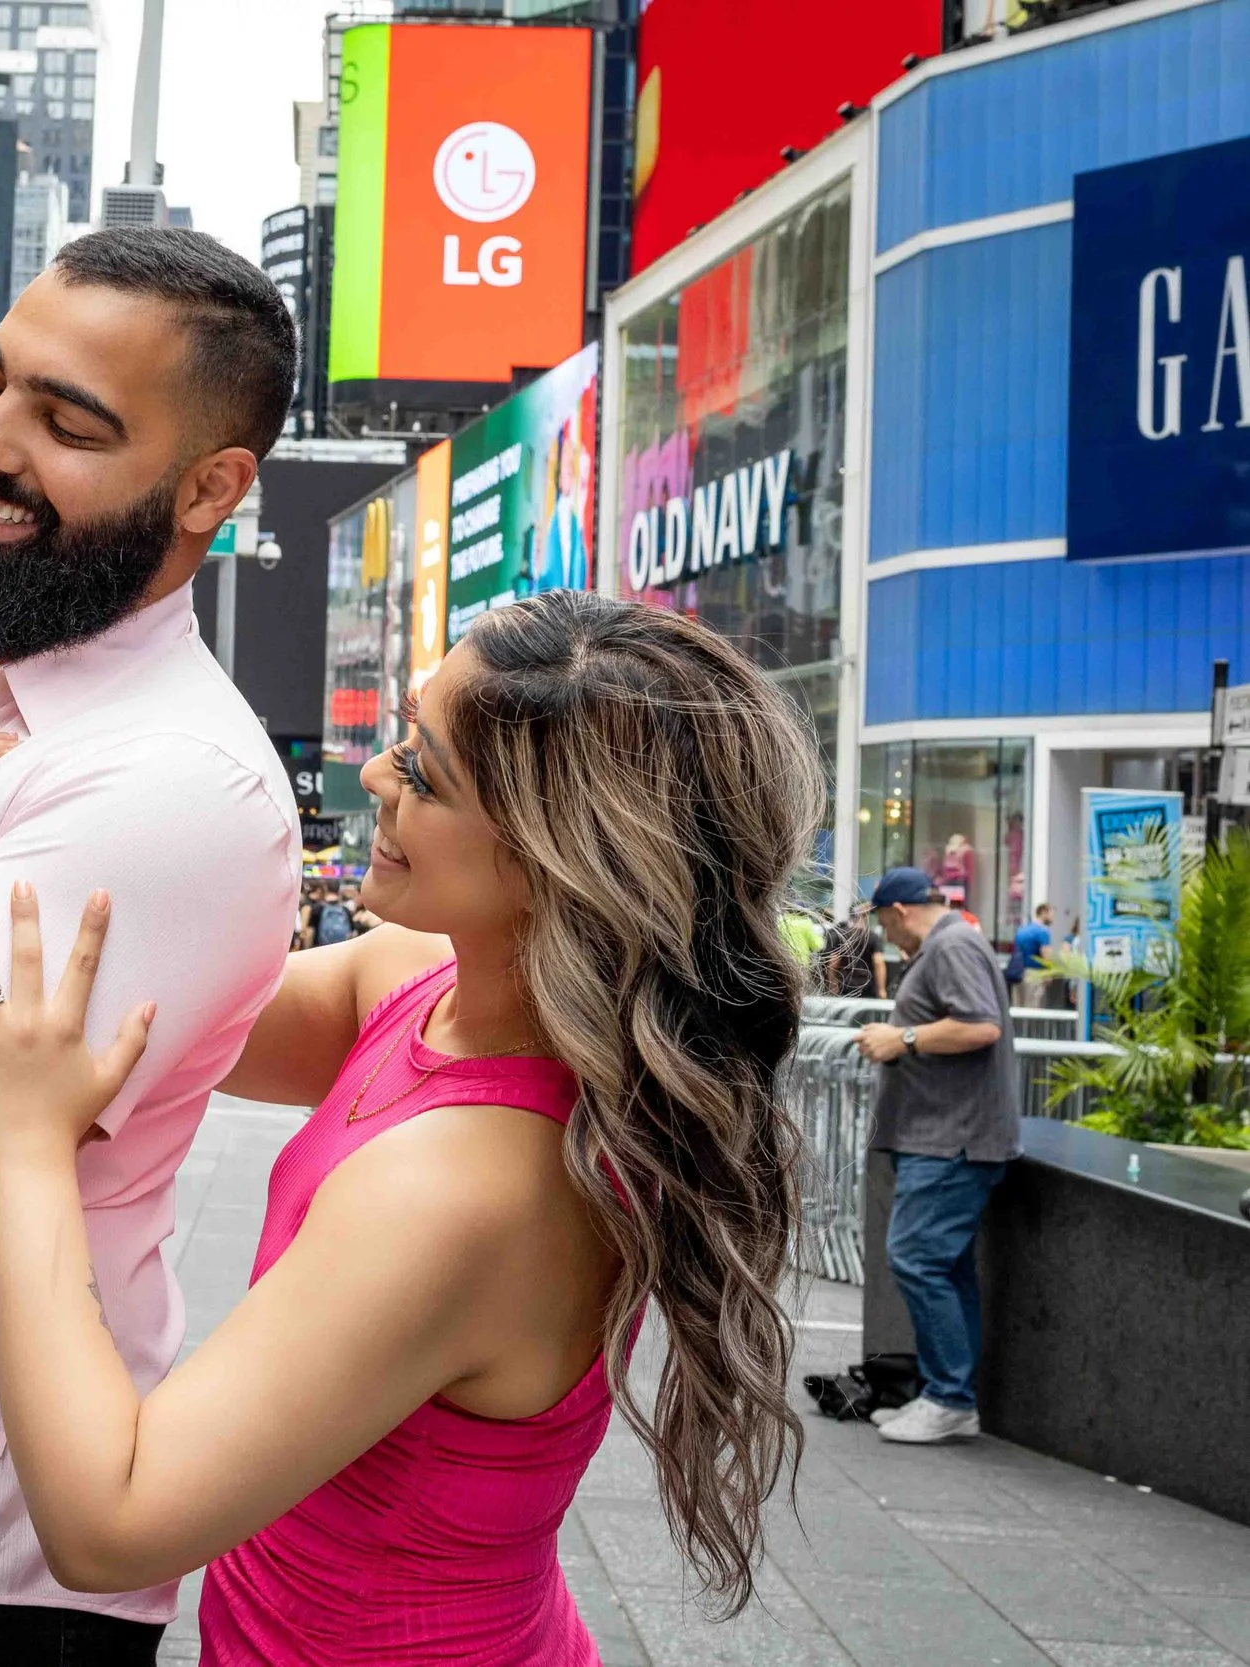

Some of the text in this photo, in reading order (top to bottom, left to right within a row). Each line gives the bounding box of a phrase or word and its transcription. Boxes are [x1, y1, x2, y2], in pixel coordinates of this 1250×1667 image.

[442, 234, 523, 286] LG
[628, 449, 792, 592] OLD NAVY
